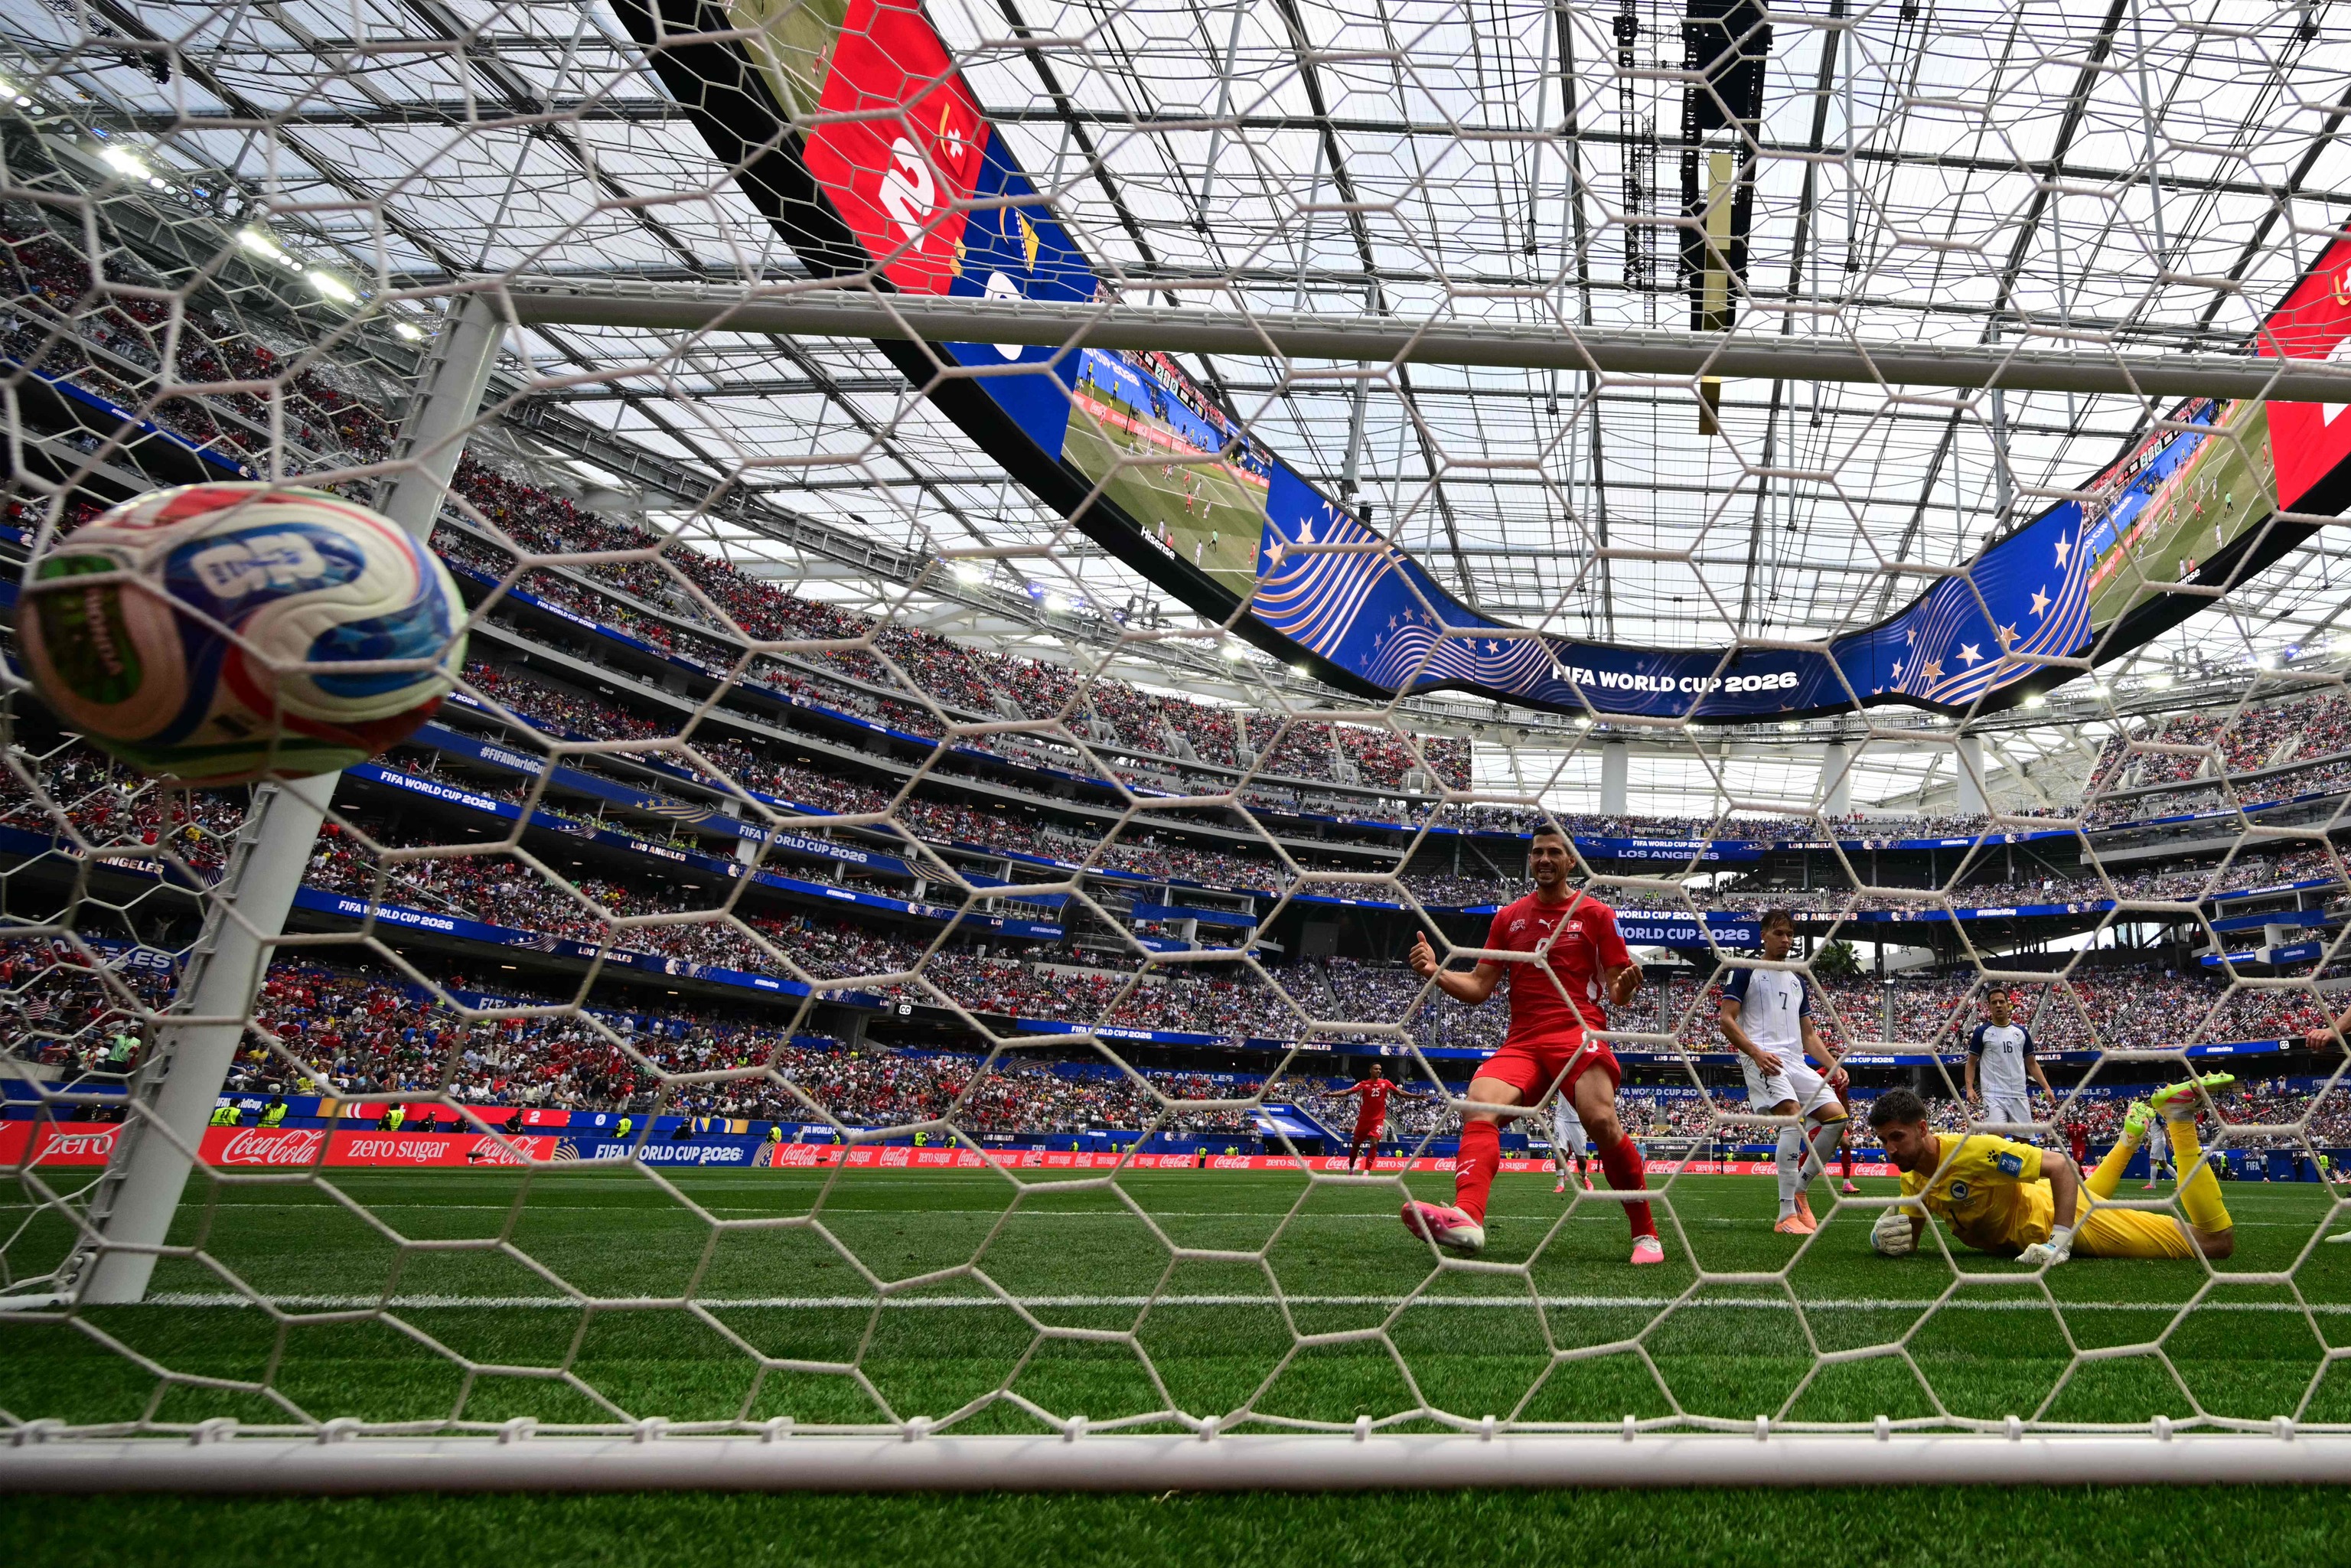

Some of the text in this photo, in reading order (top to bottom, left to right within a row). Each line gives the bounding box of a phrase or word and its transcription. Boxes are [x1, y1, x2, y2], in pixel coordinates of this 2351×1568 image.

[878, 136, 935, 253] 2
[1093, 348, 1111, 368] CUP
[1157, 367, 1162, 377] 2
[1172, 382, 1176, 391] 0
[2142, 455, 2146, 465] 2
[2092, 522, 2108, 538] CUP
[1140, 526, 1176, 560] Hisense
[537, 600, 597, 631] FIFA WORLD CUP 2026
[1552, 663, 1798, 693] FIFA WORLD CUP 2026
[455, 693, 479, 706] 2026
[380, 771, 497, 811] FIFA WORLD CUP 2026
[739, 824, 762, 839] FIFA
[807, 841, 830, 854] CUP
[829, 847, 868, 863] 2026
[631, 840, 686, 862] LOS ANGELES
[1618, 849, 1720, 860] LOS ANGELES
[96, 855, 165, 875] ANGELES
[337, 899, 361, 913] FIFA
[399, 912, 421, 923] CUP
[419, 916, 455, 930] 2026
[1616, 911, 1650, 919] WORLD
[1652, 911, 1672, 919] CUP
[1977, 908, 2017, 917] #FIFAWorldCup
[1671, 928, 1697, 940] CUP
[578, 947, 595, 957] LOS
[1779, 991, 1788, 1010] 7
[901, 1006, 910, 1014] CC
[1071, 1025, 1088, 1034] FIFA
[1114, 1028, 1129, 1038] CUP
[1128, 1031, 1153, 1040] 2026
[2003, 1041, 2013, 1054] 16
[1371, 1087, 1380, 1097] 25
[1664, 1088, 1681, 1097] CUP
[1681, 1088, 1713, 1097] 206
[2057, 1087, 2111, 1097] ANGELES
[529, 1110, 541, 1123] 2
[595, 1113, 606, 1126] 0
[812, 1126, 832, 1135] WORLD
[46, 1133, 113, 1155] zero
[221, 1128, 327, 1164] Coca-Cola
[348, 1139, 451, 1162] zero sugar
[595, 1144, 625, 1160] FIFA
[675, 1146, 700, 1162] CUP
[699, 1146, 741, 1162] 2026
[781, 1144, 821, 1166] Coca-Cola
[830, 1150, 873, 1165] zer sugar
[879, 1146, 911, 1167] Coca-Cola
[918, 1152, 952, 1165] zero sugar
[1074, 1152, 1094, 1167] Coca-Cola
[999, 1155, 1018, 1165] sugar
[1048, 1156, 1071, 1166] zero sugar
[1159, 1154, 1192, 1169] Coca-Cola
[1214, 1155, 1254, 1169] Coca-Cola
[1266, 1159, 1312, 1170] zero sugar
[2245, 1161, 2260, 1171] FIFA
[1505, 1162, 1529, 1172] sugar
[1646, 1160, 1683, 1174] Coca-Cola
[1695, 1164, 1739, 1175] zero sugar
[1824, 1163, 1842, 1175] ugar
[1854, 1162, 1887, 1176] Coca-Cola
